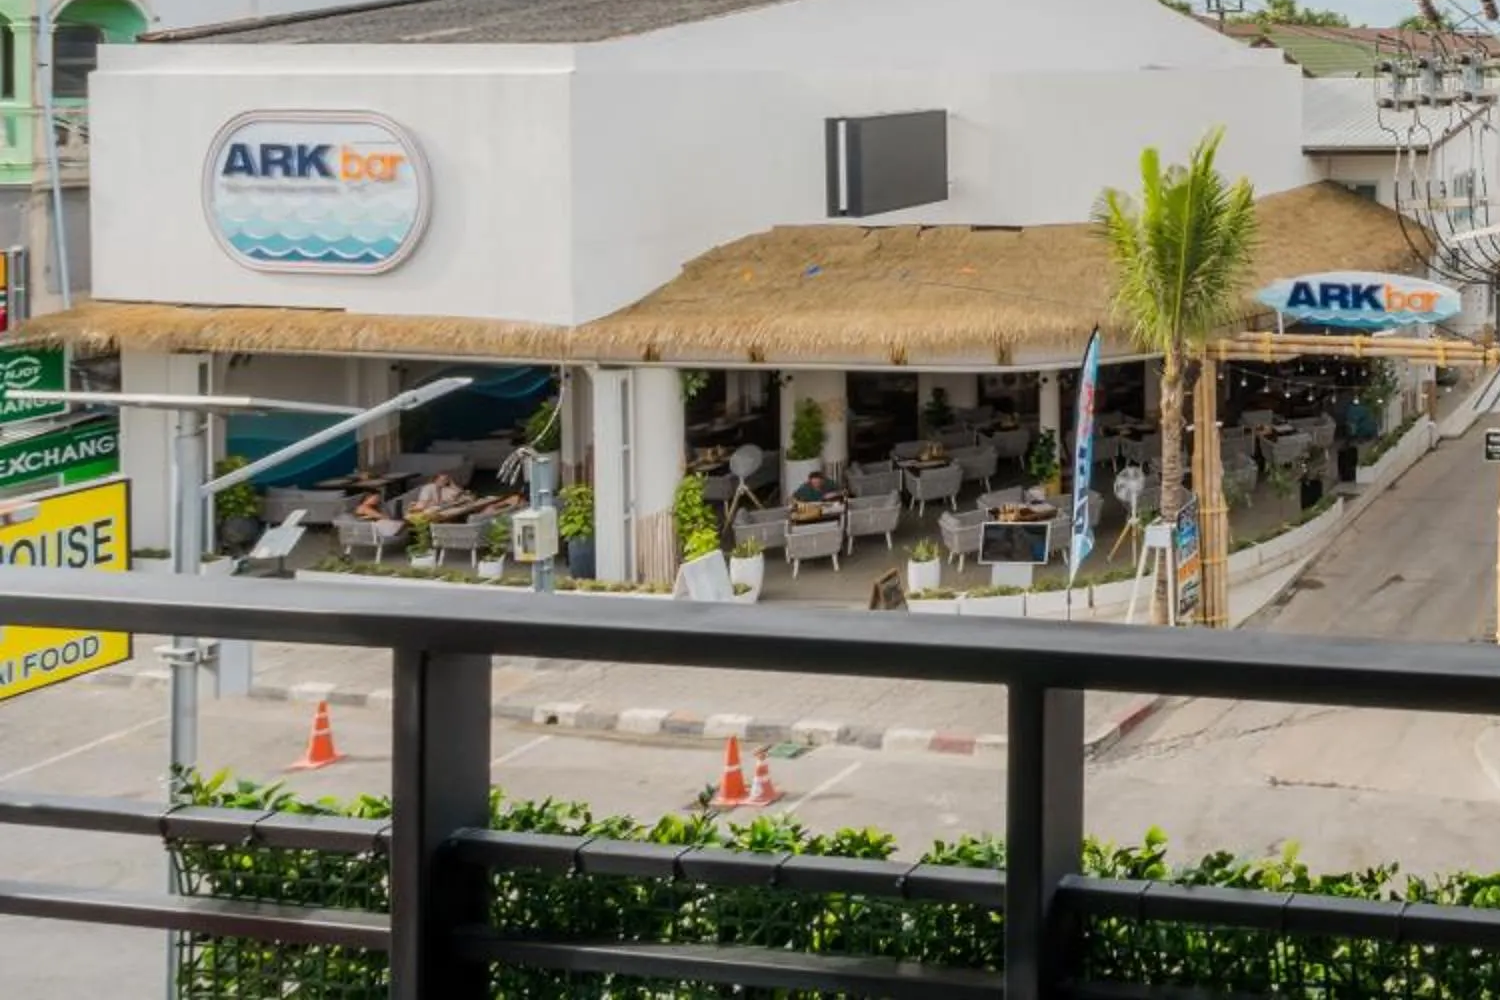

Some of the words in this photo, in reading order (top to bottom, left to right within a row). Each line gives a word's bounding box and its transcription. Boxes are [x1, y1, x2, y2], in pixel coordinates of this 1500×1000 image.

[222, 143, 336, 178] ARK
[340, 146, 405, 182] bar
[1286, 281, 1385, 311] ARK
[1384, 283, 1441, 312] bar
[0, 518, 113, 568] OUSE
[23, 635, 99, 678] FOOD
